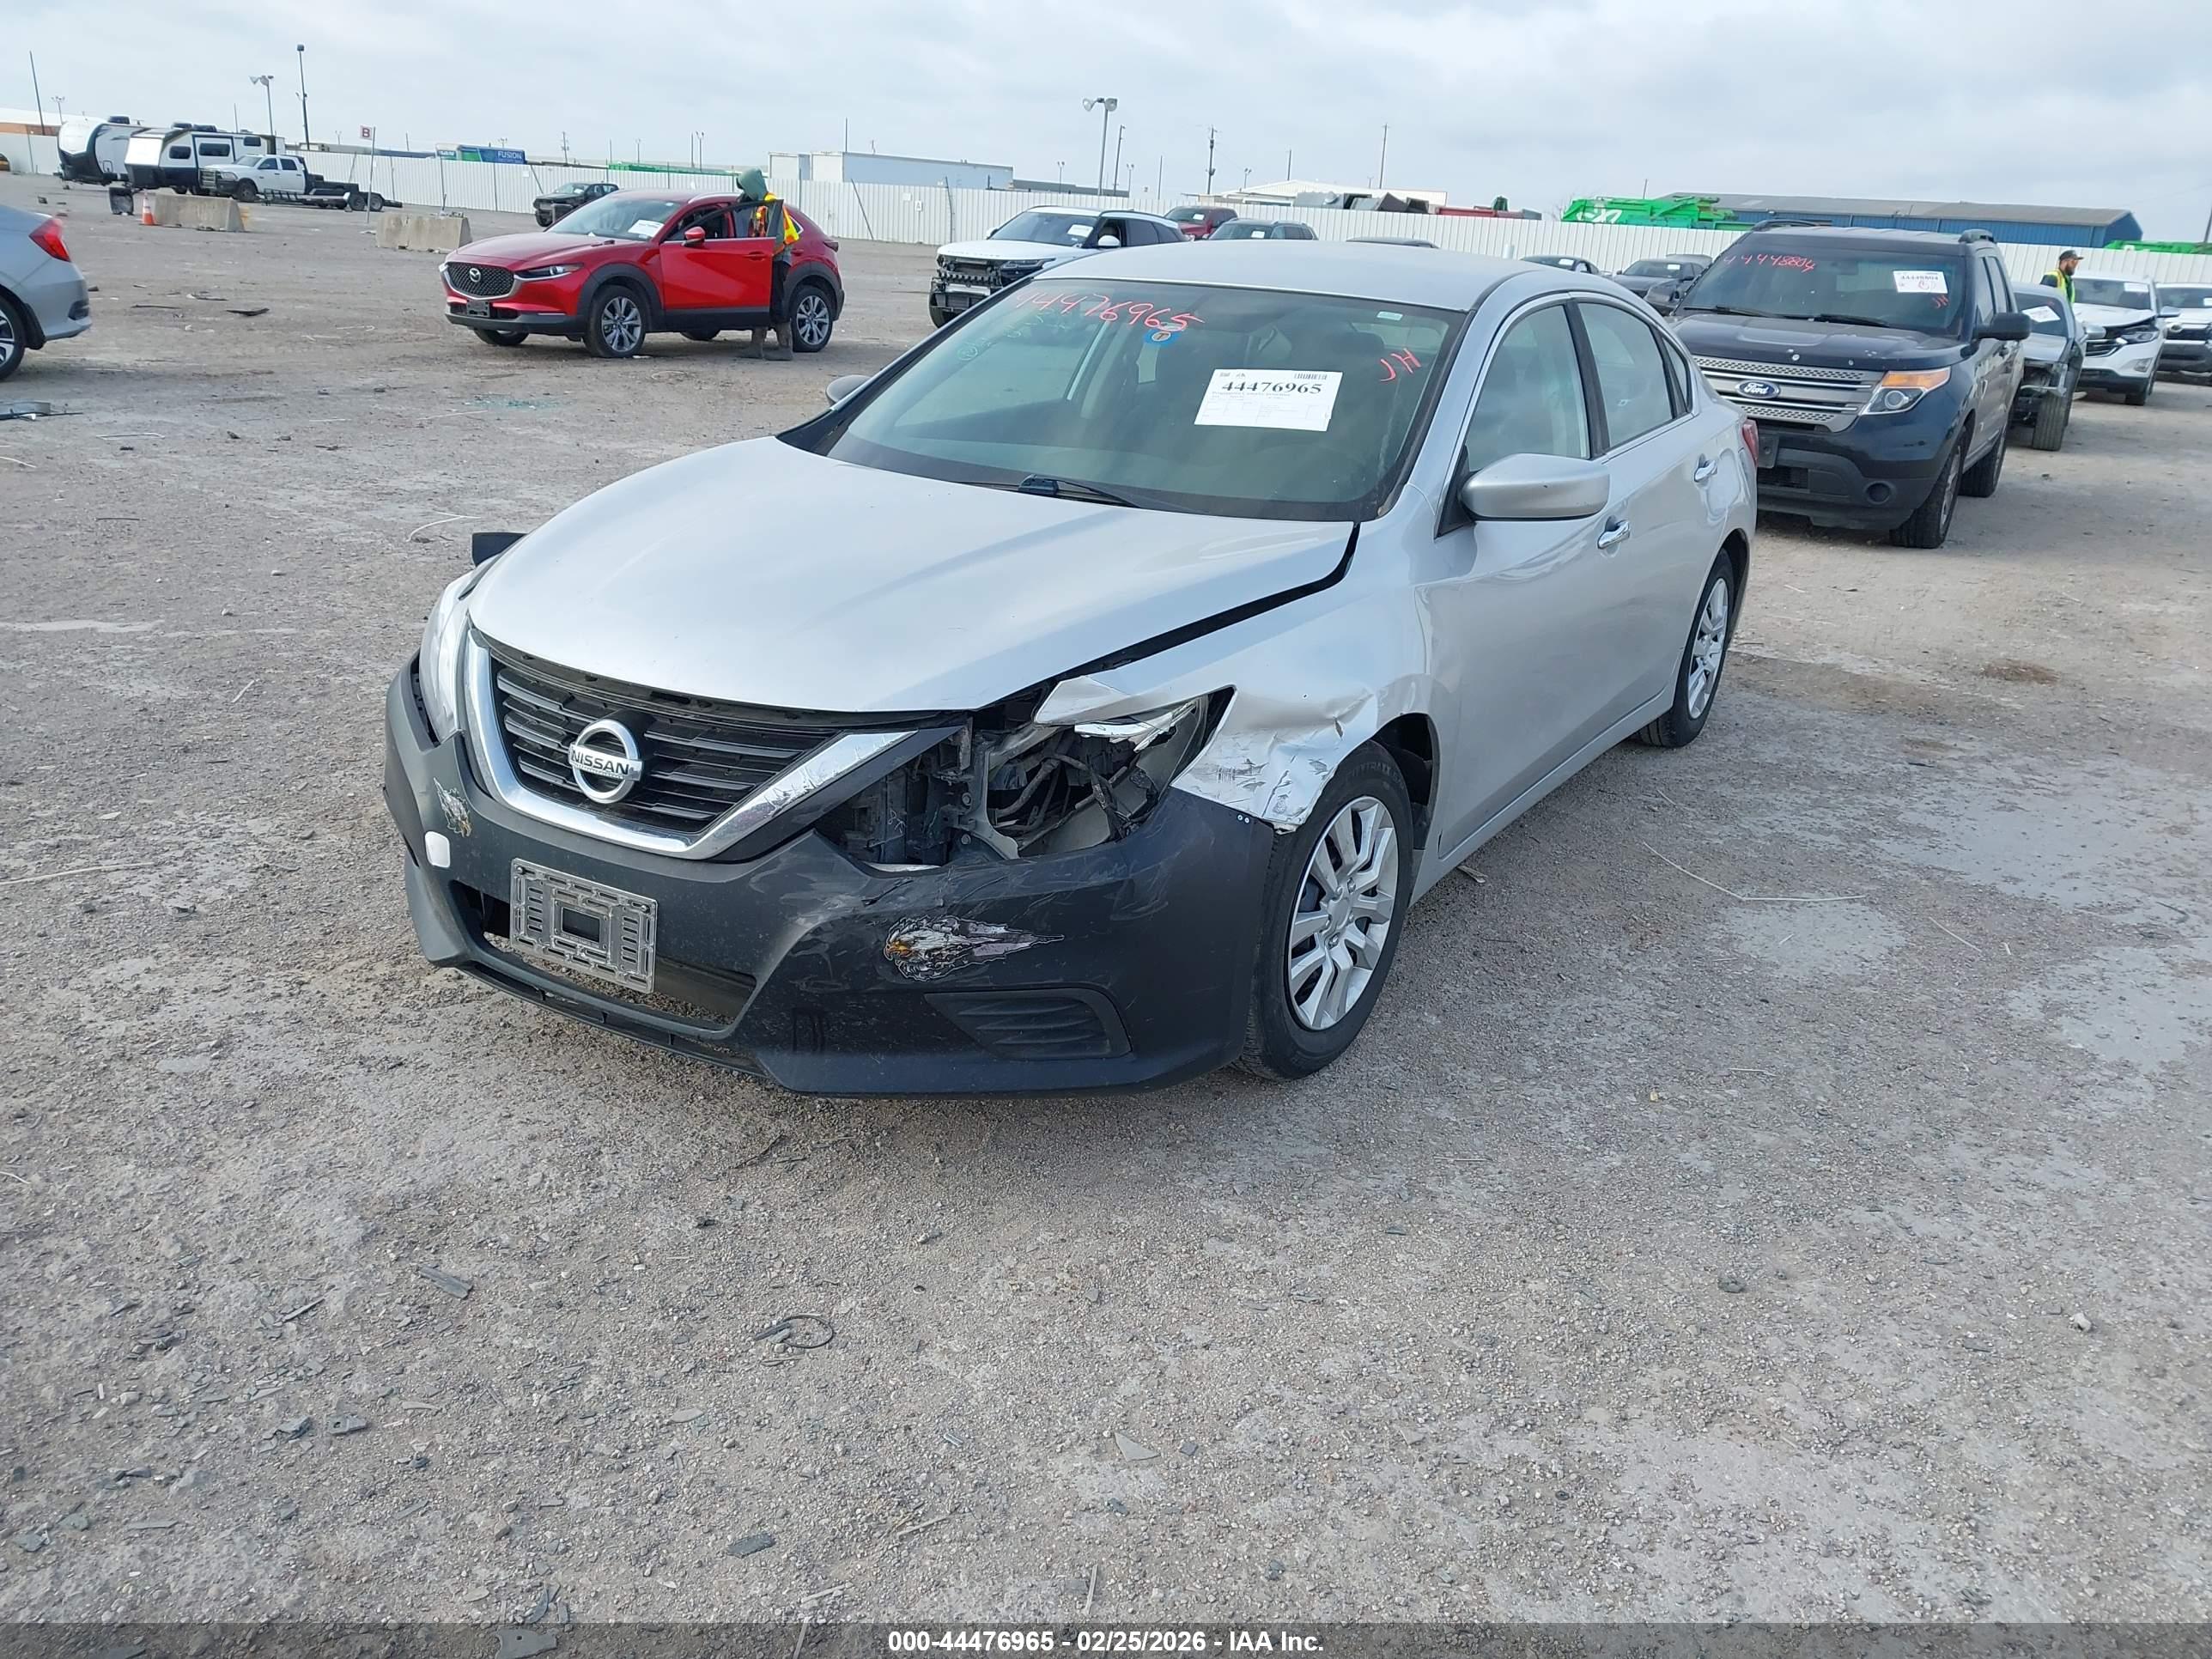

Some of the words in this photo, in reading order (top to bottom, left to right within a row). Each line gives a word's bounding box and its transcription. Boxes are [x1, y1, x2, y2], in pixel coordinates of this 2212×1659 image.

[362, 127, 371, 138] B
[497, 149, 523, 160] FUSION
[1221, 381, 1323, 395] 44476965
[1743, 382, 1770, 395] Ford
[570, 750, 630, 775] NISSAN
